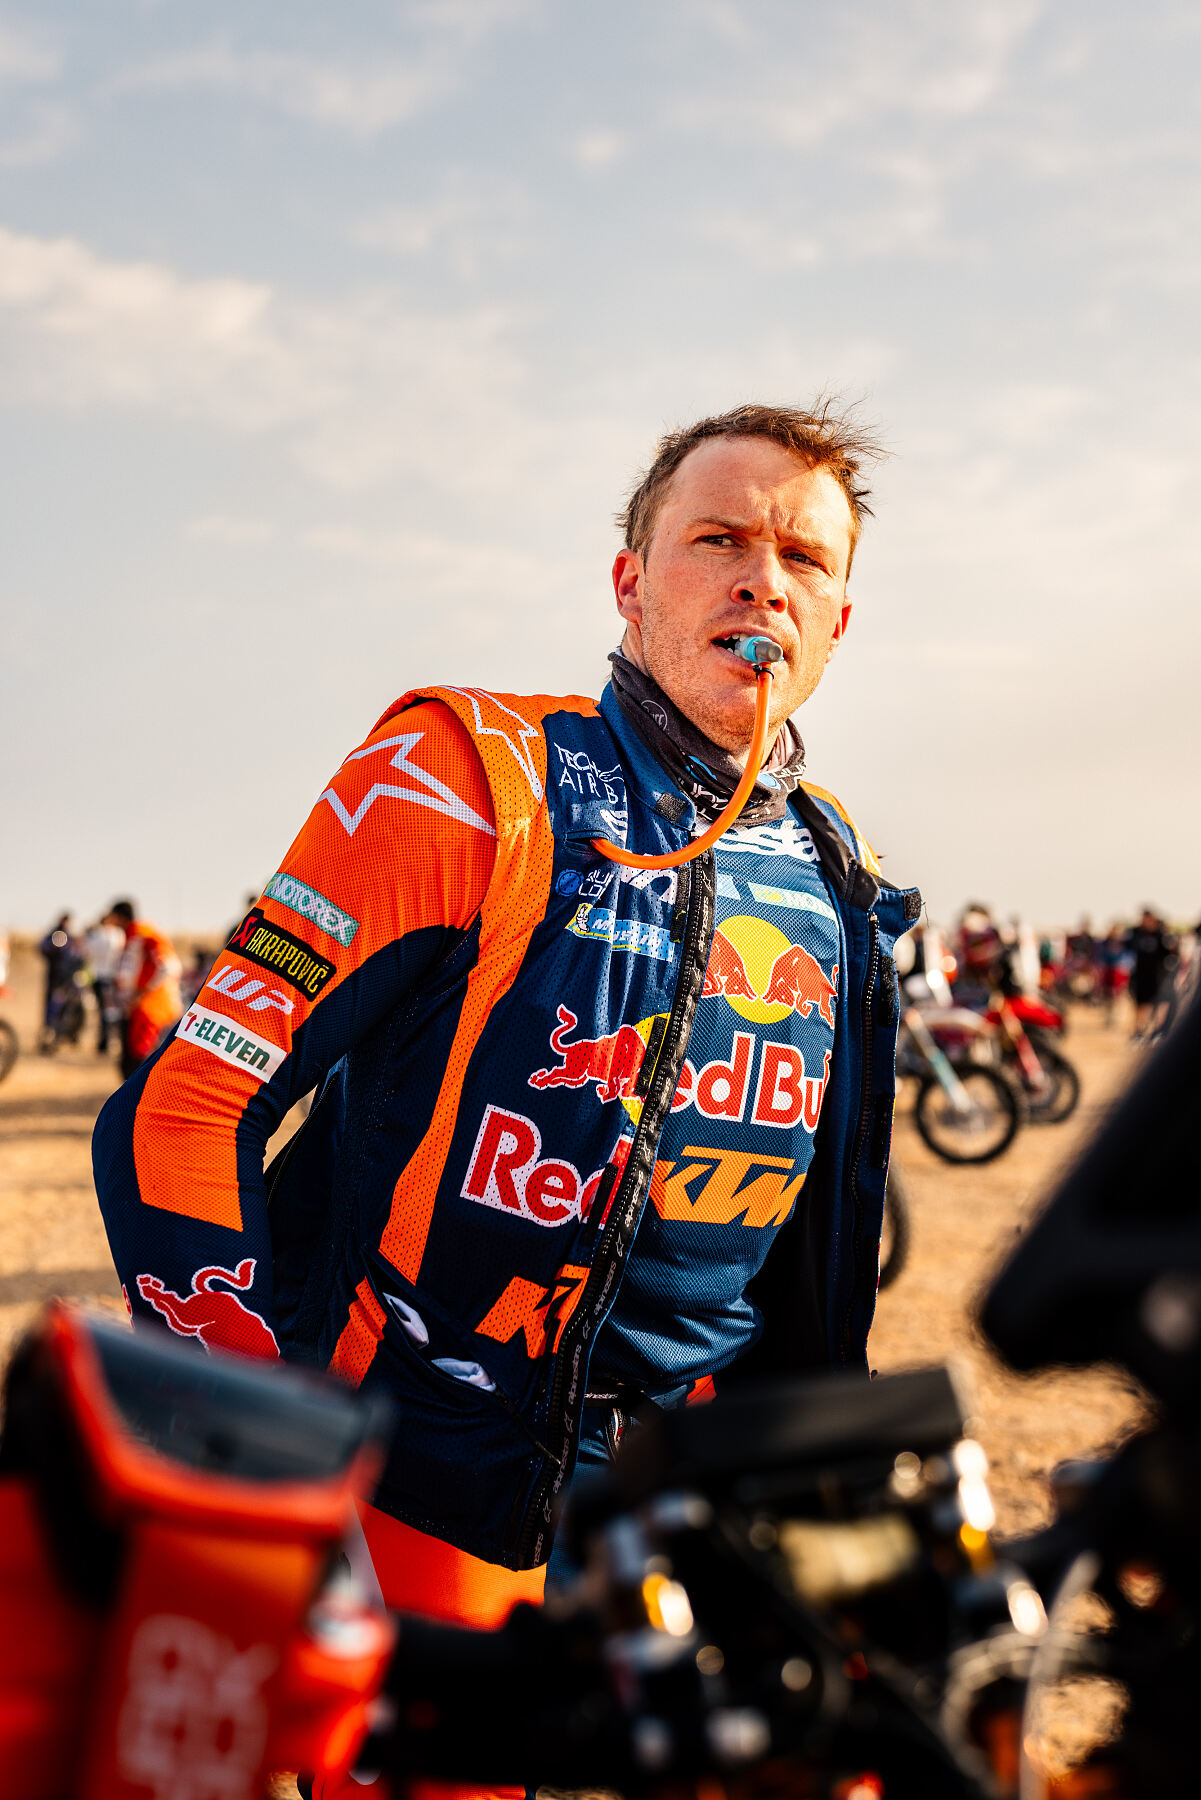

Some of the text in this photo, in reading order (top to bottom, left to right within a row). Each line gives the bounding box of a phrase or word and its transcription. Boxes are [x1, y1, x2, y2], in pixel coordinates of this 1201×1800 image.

[270, 874, 352, 941] MOTOREX
[670, 1030, 756, 1123] ed
[648, 1144, 807, 1229] KTM
